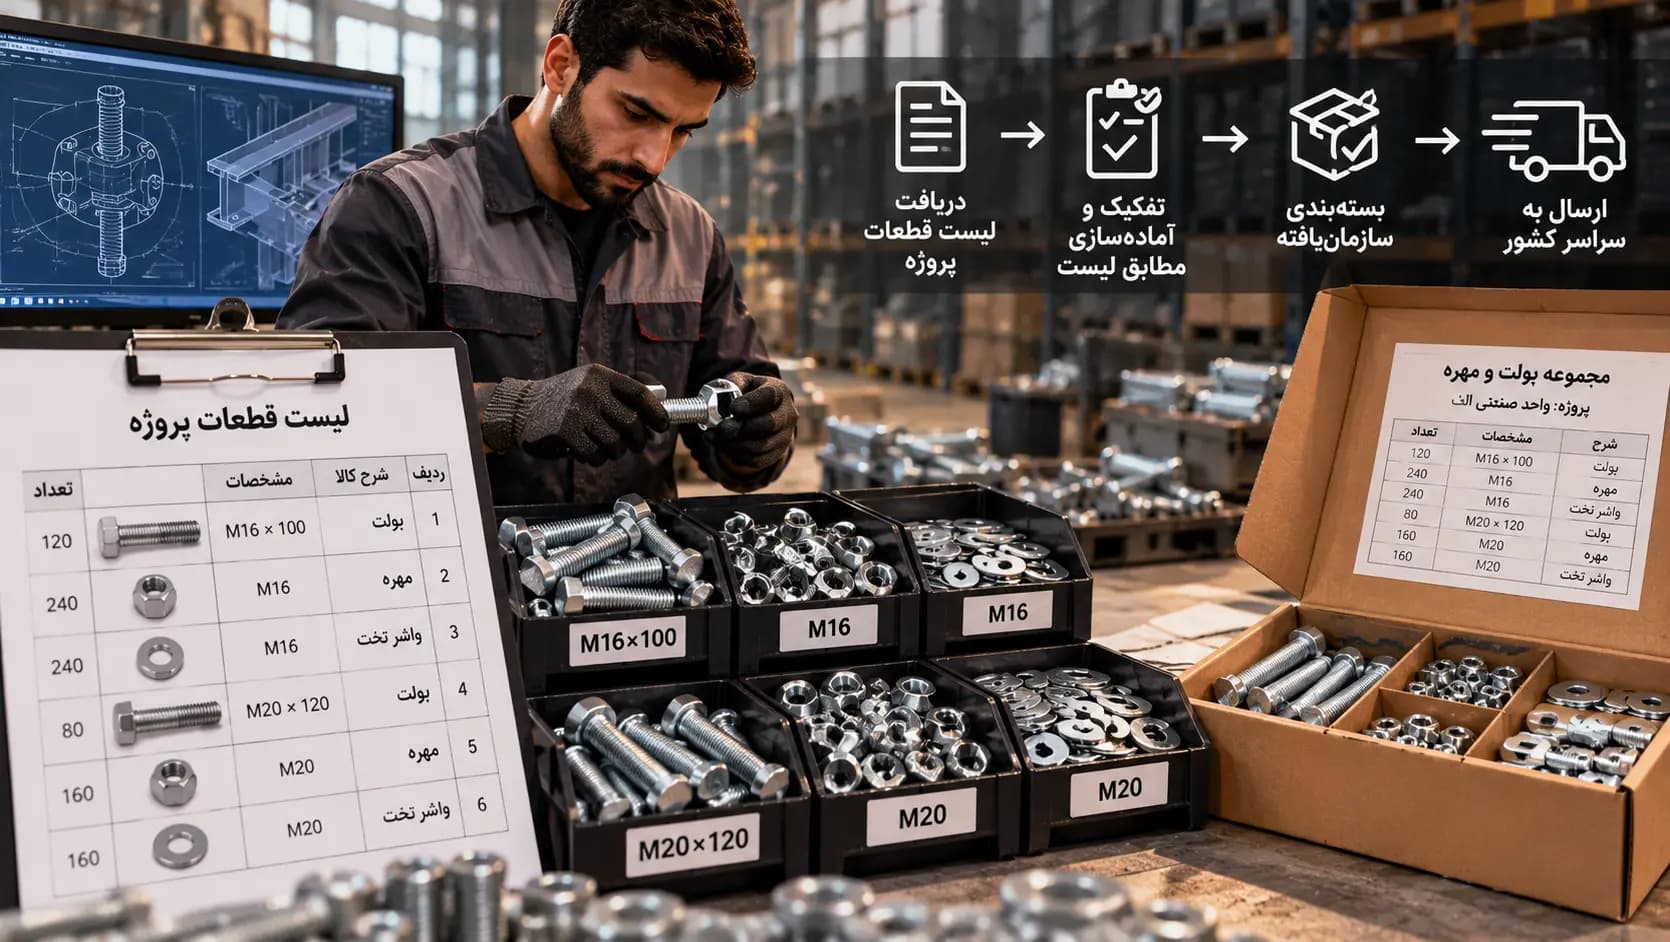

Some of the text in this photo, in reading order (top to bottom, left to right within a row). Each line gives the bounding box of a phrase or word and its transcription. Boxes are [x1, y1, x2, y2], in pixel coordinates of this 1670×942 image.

[1444, 366, 1479, 382] مهره
[1484, 369, 1493, 384] و
[1544, 369, 1610, 388] مجموعه
[1521, 398, 1550, 414] واحد
[1554, 401, 1590, 418] پروژه:
[130, 404, 349, 441] لیست قطعات پروژه
[1412, 427, 1438, 437] تعداد
[1482, 431, 1532, 443] مشخصات
[1593, 439, 1617, 452] شرح
[1412, 448, 1430, 459] 120
[1476, 453, 1499, 464] M16
[1513, 456, 1533, 467] 100
[413, 466, 445, 482] ردیف
[1407, 468, 1427, 479] 240
[1594, 462, 1618, 475] بولت
[226, 472, 292, 488] مشخصات
[336, 468, 388, 486] شرح کالا
[1489, 475, 1512, 487] M16
[34, 482, 72, 497] تعداد
[1403, 488, 1423, 499] 240
[1594, 486, 1617, 497] مهره
[1486, 496, 1509, 508] M16
[432, 512, 438, 525] 1
[1404, 509, 1417, 519] 80
[1597, 507, 1620, 520] واشر
[226, 520, 305, 538] M16 × 100
[372, 514, 403, 531] بولت
[1466, 516, 1490, 527] M20
[1504, 520, 1524, 531] 120
[42, 534, 72, 549] 120
[1398, 530, 1416, 541] 160
[1586, 528, 1610, 543] بولت
[1479, 538, 1504, 551] M20
[1394, 550, 1412, 561] 160
[1584, 552, 1608, 564] مهره
[1476, 560, 1500, 572] M20
[383, 576, 412, 589] مهره
[440, 569, 449, 582] 2
[1560, 571, 1611, 588] واشر تخت
[257, 580, 290, 596] M16
[47, 596, 77, 612] 240
[989, 603, 1028, 623] M16
[450, 625, 458, 639] 3
[809, 618, 850, 638] M16
[357, 627, 422, 647] واشر تخت
[265, 639, 298, 655] M16
[52, 658, 83, 675] 240
[398, 686, 429, 704] بولت
[459, 682, 467, 696] 4
[247, 696, 329, 718] M20 × 120
[63, 722, 83, 738] 80
[469, 739, 477, 753] 5
[409, 748, 439, 763] مهره
[280, 759, 314, 776] M20
[64, 785, 93, 803] 160
[1099, 777, 1142, 801] M20
[478, 797, 486, 811] 6
[384, 802, 450, 823] واشر تخت
[900, 804, 946, 829] M20
[288, 820, 322, 837] M20
[68, 850, 99, 868] 160
